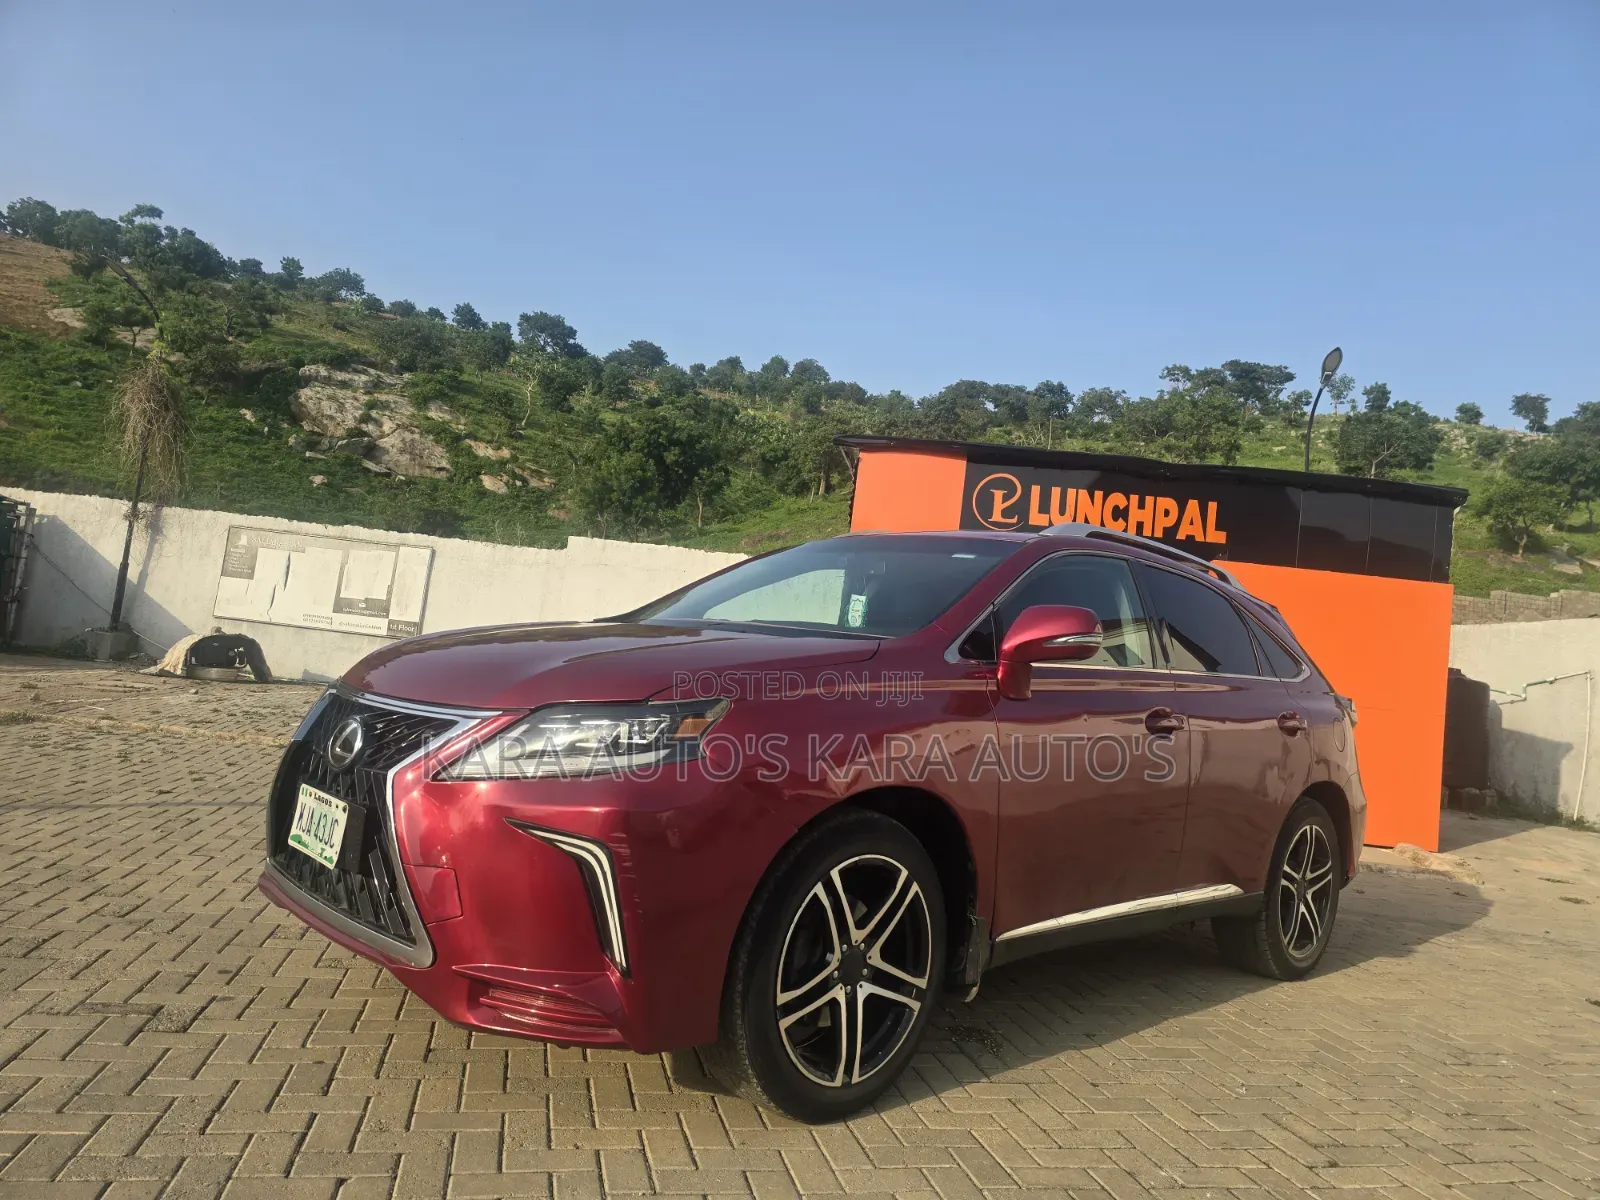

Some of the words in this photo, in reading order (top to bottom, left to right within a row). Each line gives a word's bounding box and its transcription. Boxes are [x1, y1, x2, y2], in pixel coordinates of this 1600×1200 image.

[1029, 485, 1227, 544] LUNCHPAL
[398, 624, 415, 632] Floor
[314, 791, 333, 808] LAGOS
